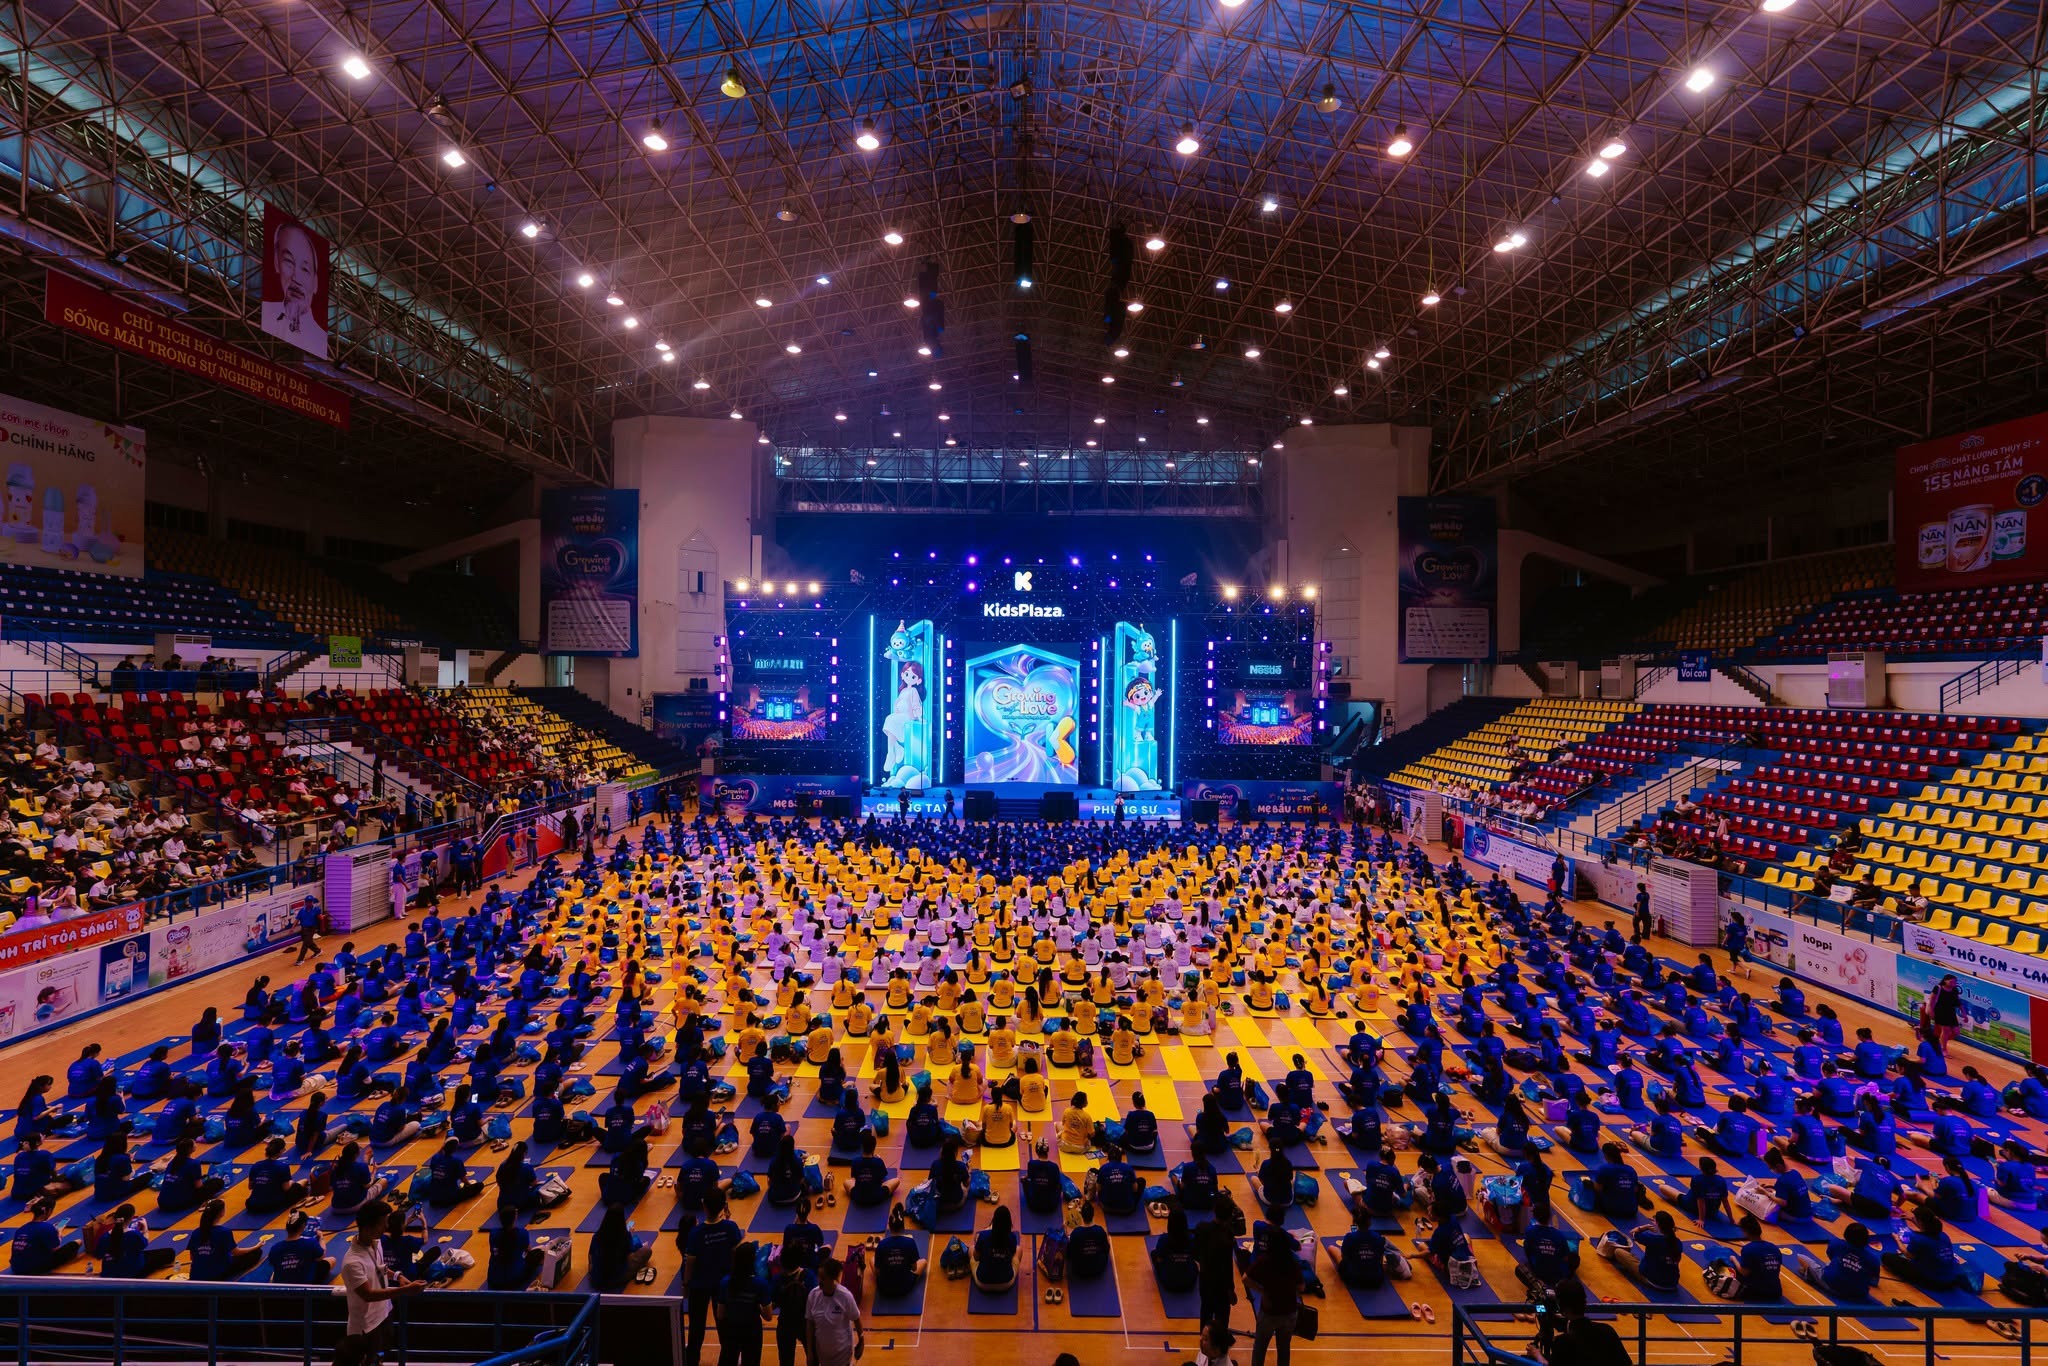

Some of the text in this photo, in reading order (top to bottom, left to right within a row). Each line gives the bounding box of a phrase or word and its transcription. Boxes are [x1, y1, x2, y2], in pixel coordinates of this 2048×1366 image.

[122, 311, 153, 333] CHỦ
[157, 325, 190, 348] TỊCH
[216, 347, 237, 366] CHÍ
[241, 358, 273, 380] MINH
[289, 378, 308, 396] ĐẠI
[63, 307, 341, 423] SỐNG MÃI TRONG SỰ NGHIỆP CỦA CHÚNG TA
[11, 433, 95, 462] CHÍNH HÃNG
[1953, 463, 1990, 481] NÂNG
[1953, 519, 1987, 533] NAN
[1014, 571, 1033, 591] K
[1681, 668, 1708, 678] Voi con
[992, 683, 1057, 705] Growing
[1020, 701, 1058, 716] Love
[1141, 804, 1158, 816] SỰ
[22, 934, 47, 954] TRÍ
[49, 929, 77, 946] TỎA
[80, 919, 118, 939] SÁNG!
[1803, 934, 1833, 951] hoppi
[1947, 945, 1976, 962] THỎ
[1979, 955, 2007, 972] CON
